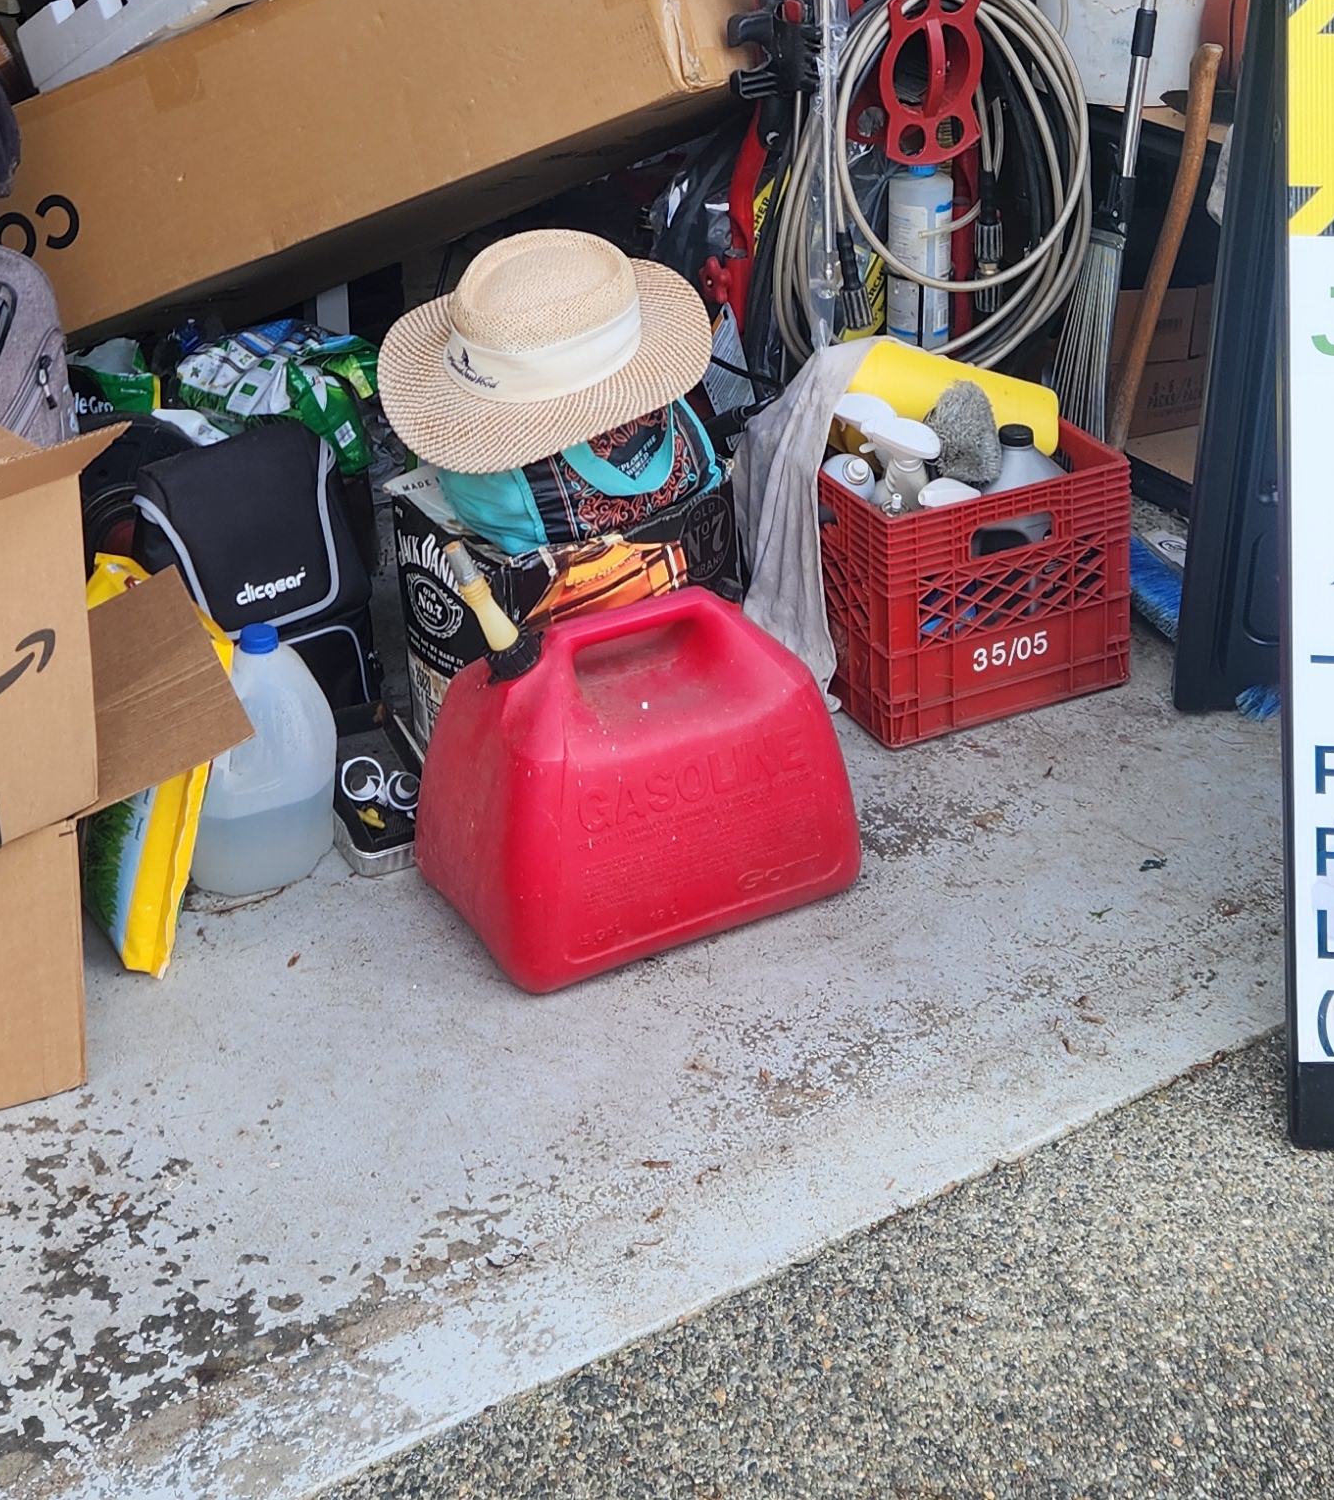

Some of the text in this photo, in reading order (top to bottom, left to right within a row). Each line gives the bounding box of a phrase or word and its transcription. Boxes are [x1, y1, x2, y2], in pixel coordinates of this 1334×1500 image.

[402, 480, 433, 493] MADE
[693, 501, 716, 522] OLD
[396, 528, 465, 599] JACK DANI
[693, 552, 726, 577] BRAND
[236, 568, 307, 607] clicgear
[422, 586, 437, 601] Old
[971, 629, 1051, 674] 35/05
[576, 725, 808, 834] GASOLINE
